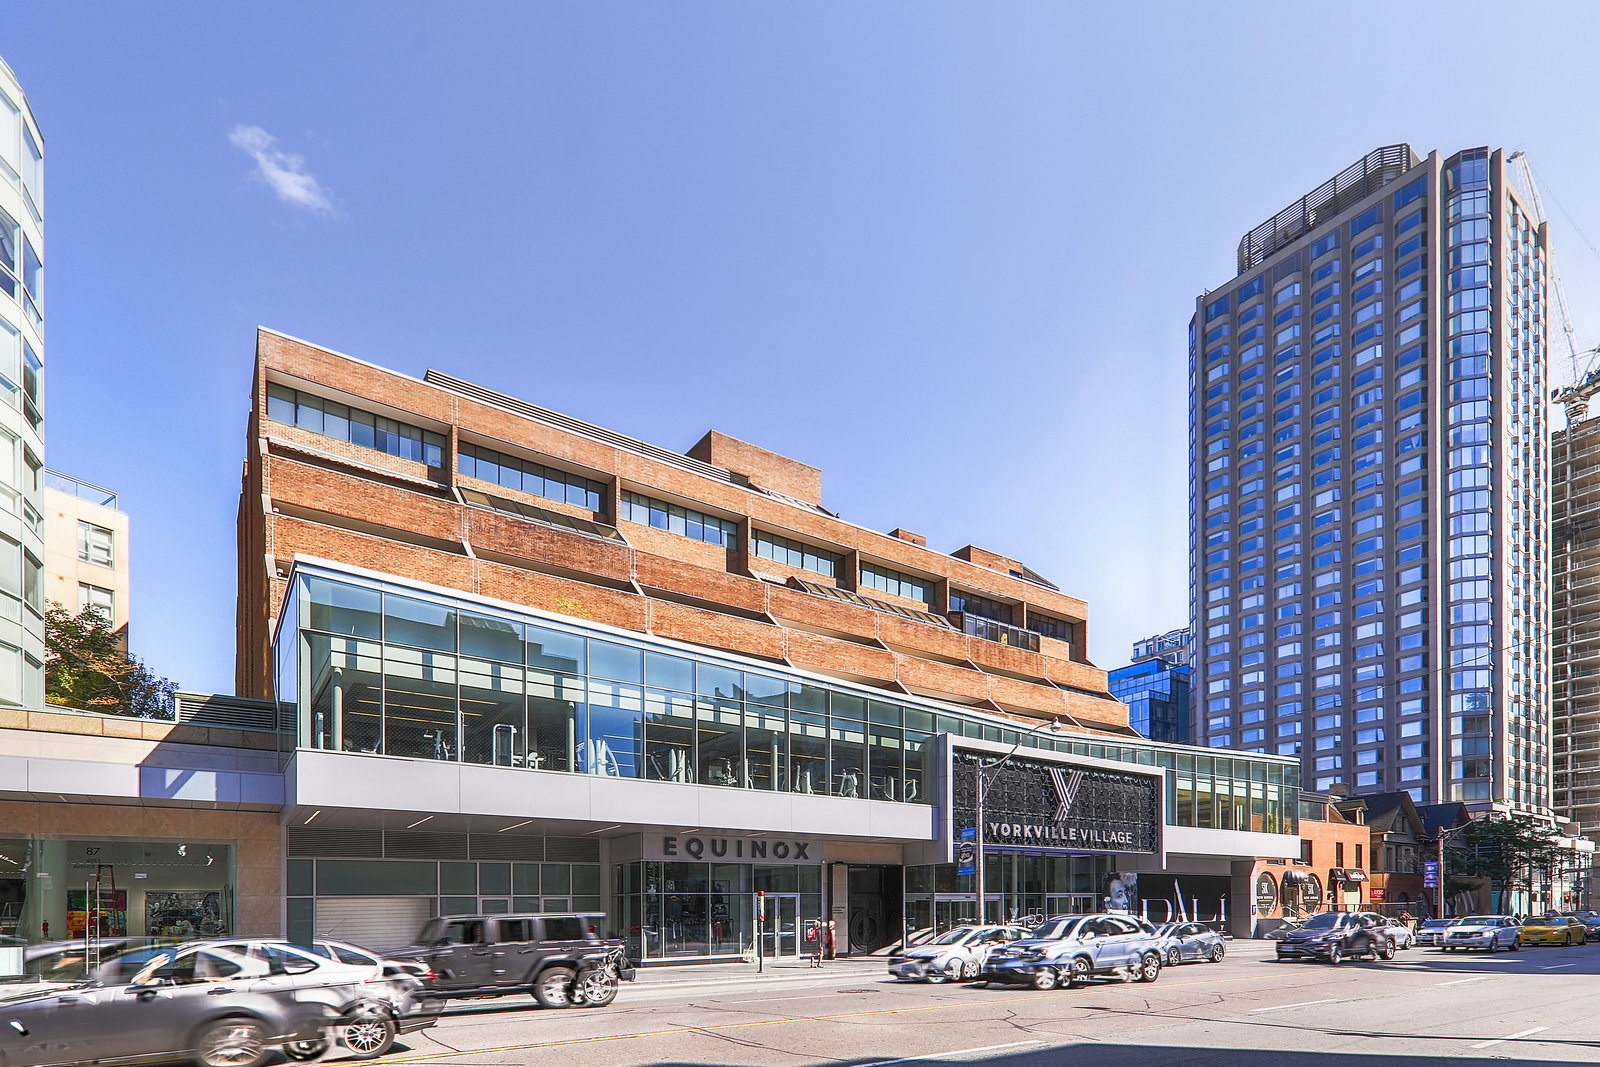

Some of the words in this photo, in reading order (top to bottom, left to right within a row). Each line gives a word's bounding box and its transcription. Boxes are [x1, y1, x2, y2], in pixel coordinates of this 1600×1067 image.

[989, 822, 1077, 841] YORKVILLE
[1080, 828, 1133, 844] VILLAGE
[86, 847, 101, 856] 87
[664, 836, 809, 860] EQUINOX
[1027, 907, 1044, 924] 55
